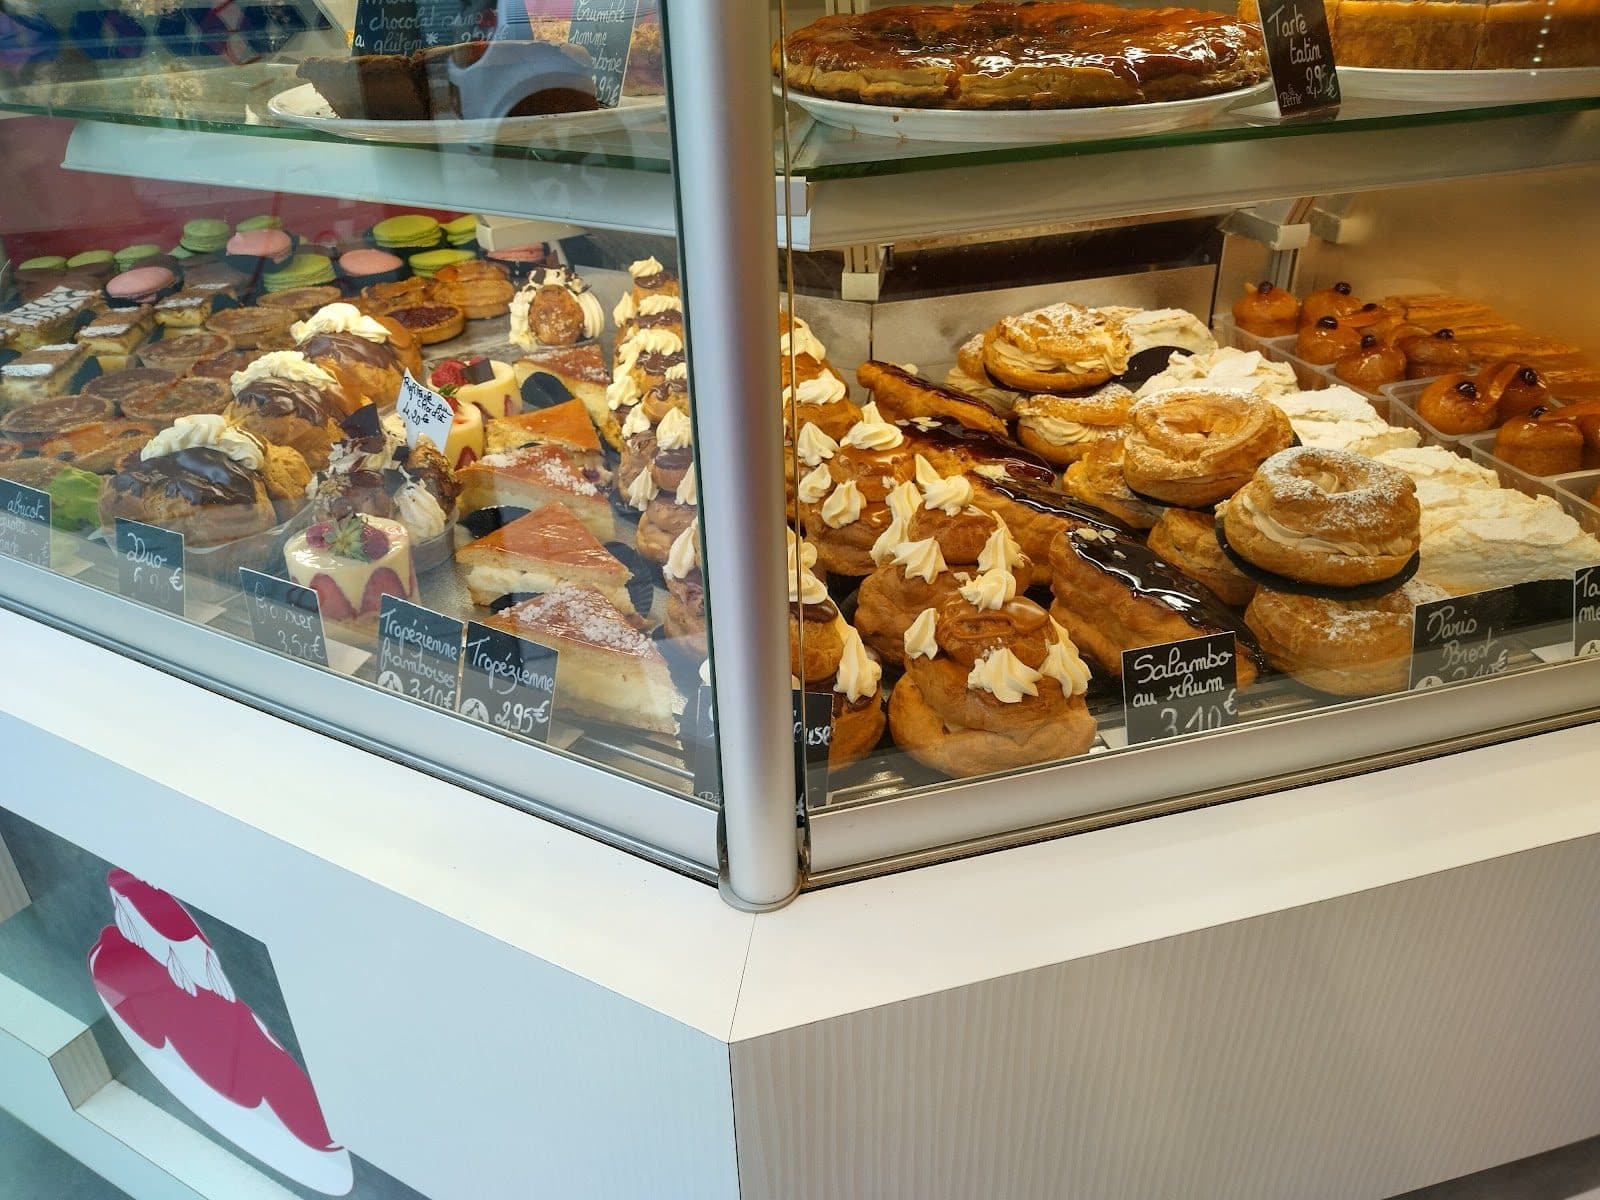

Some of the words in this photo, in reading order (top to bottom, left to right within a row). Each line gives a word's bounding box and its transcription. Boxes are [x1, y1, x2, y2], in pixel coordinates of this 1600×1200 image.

[369, 5, 436, 31] chocolat
[1267, 5, 1308, 37] Tarte
[1289, 38, 1322, 64] tatin
[127, 532, 168, 568] Duo
[380, 608, 458, 660] Tropézienne
[1427, 606, 1478, 642] Paris
[381, 637, 456, 688] framboises
[468, 636, 554, 695] Tropézienne
[1133, 642, 1233, 684] Salambo
[1439, 627, 1499, 672] Brest
[1132, 692, 1158, 708] au
[1166, 673, 1225, 701] rhum
